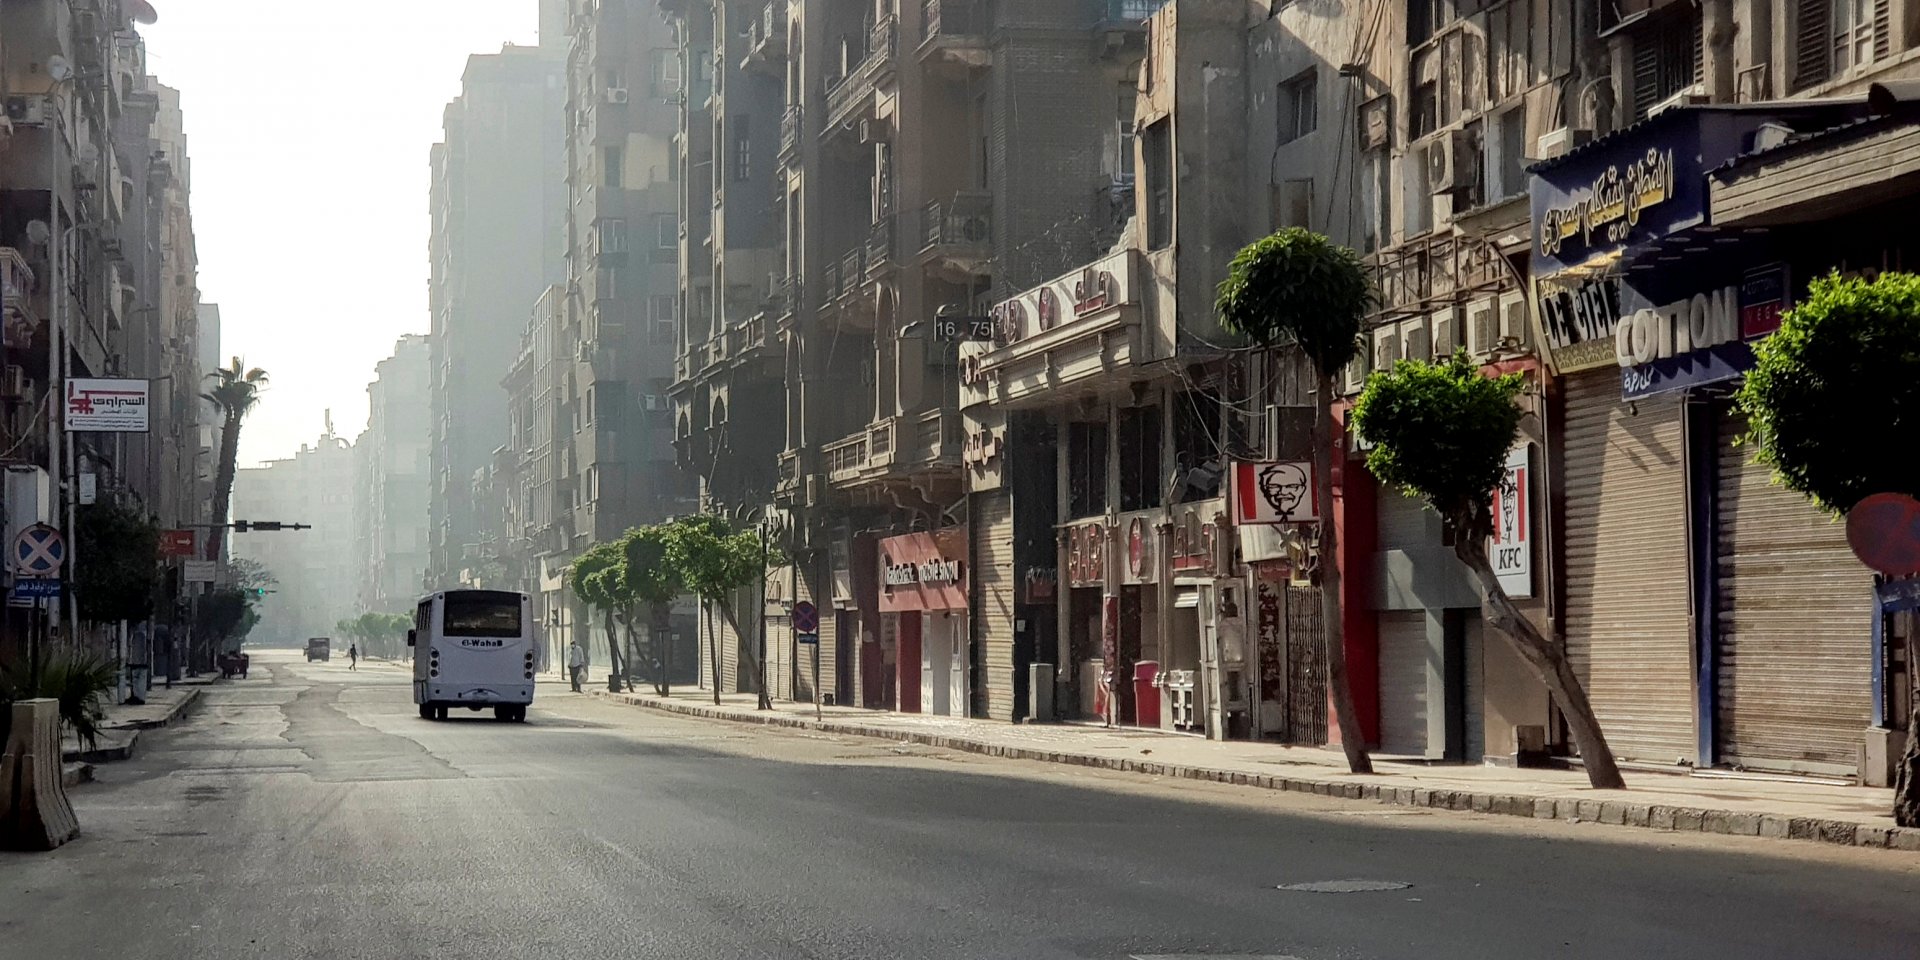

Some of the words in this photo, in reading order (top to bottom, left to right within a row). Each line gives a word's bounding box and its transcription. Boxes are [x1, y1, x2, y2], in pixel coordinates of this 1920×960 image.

[1584, 164, 1625, 247] بيتكلم
[1628, 147, 1673, 226] القطن
[936, 321, 955, 336] 16
[970, 321, 990, 336] 75
[1539, 293, 1571, 349] LE
[1571, 281, 1617, 342] CIEL
[1615, 286, 1738, 367] COTTON
[1498, 547, 1521, 570] KFC
